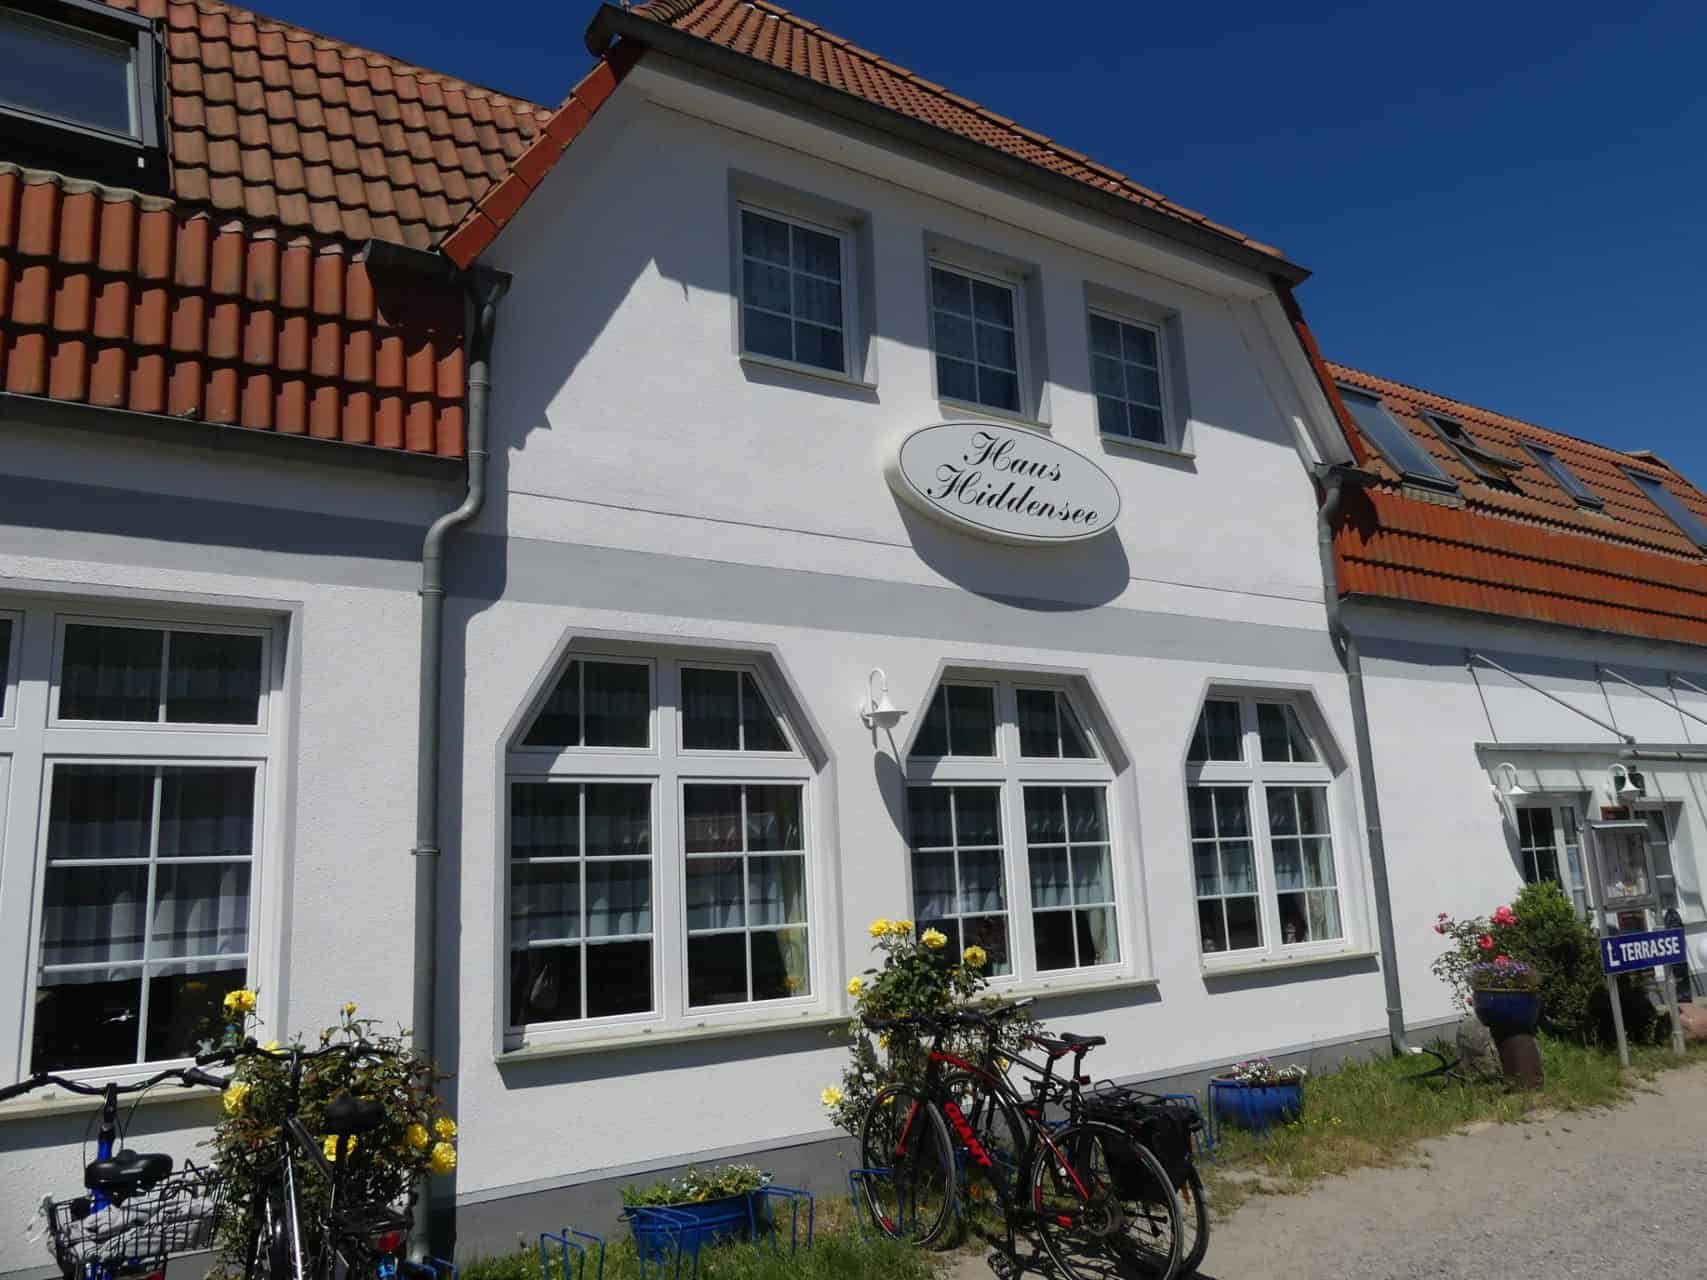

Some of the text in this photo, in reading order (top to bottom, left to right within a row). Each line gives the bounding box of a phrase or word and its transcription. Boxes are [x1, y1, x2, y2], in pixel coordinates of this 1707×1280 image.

[963, 431, 1061, 482] Haus
[927, 463, 1100, 526] Hiddensee
[1620, 936, 1680, 961] TERRASSE
